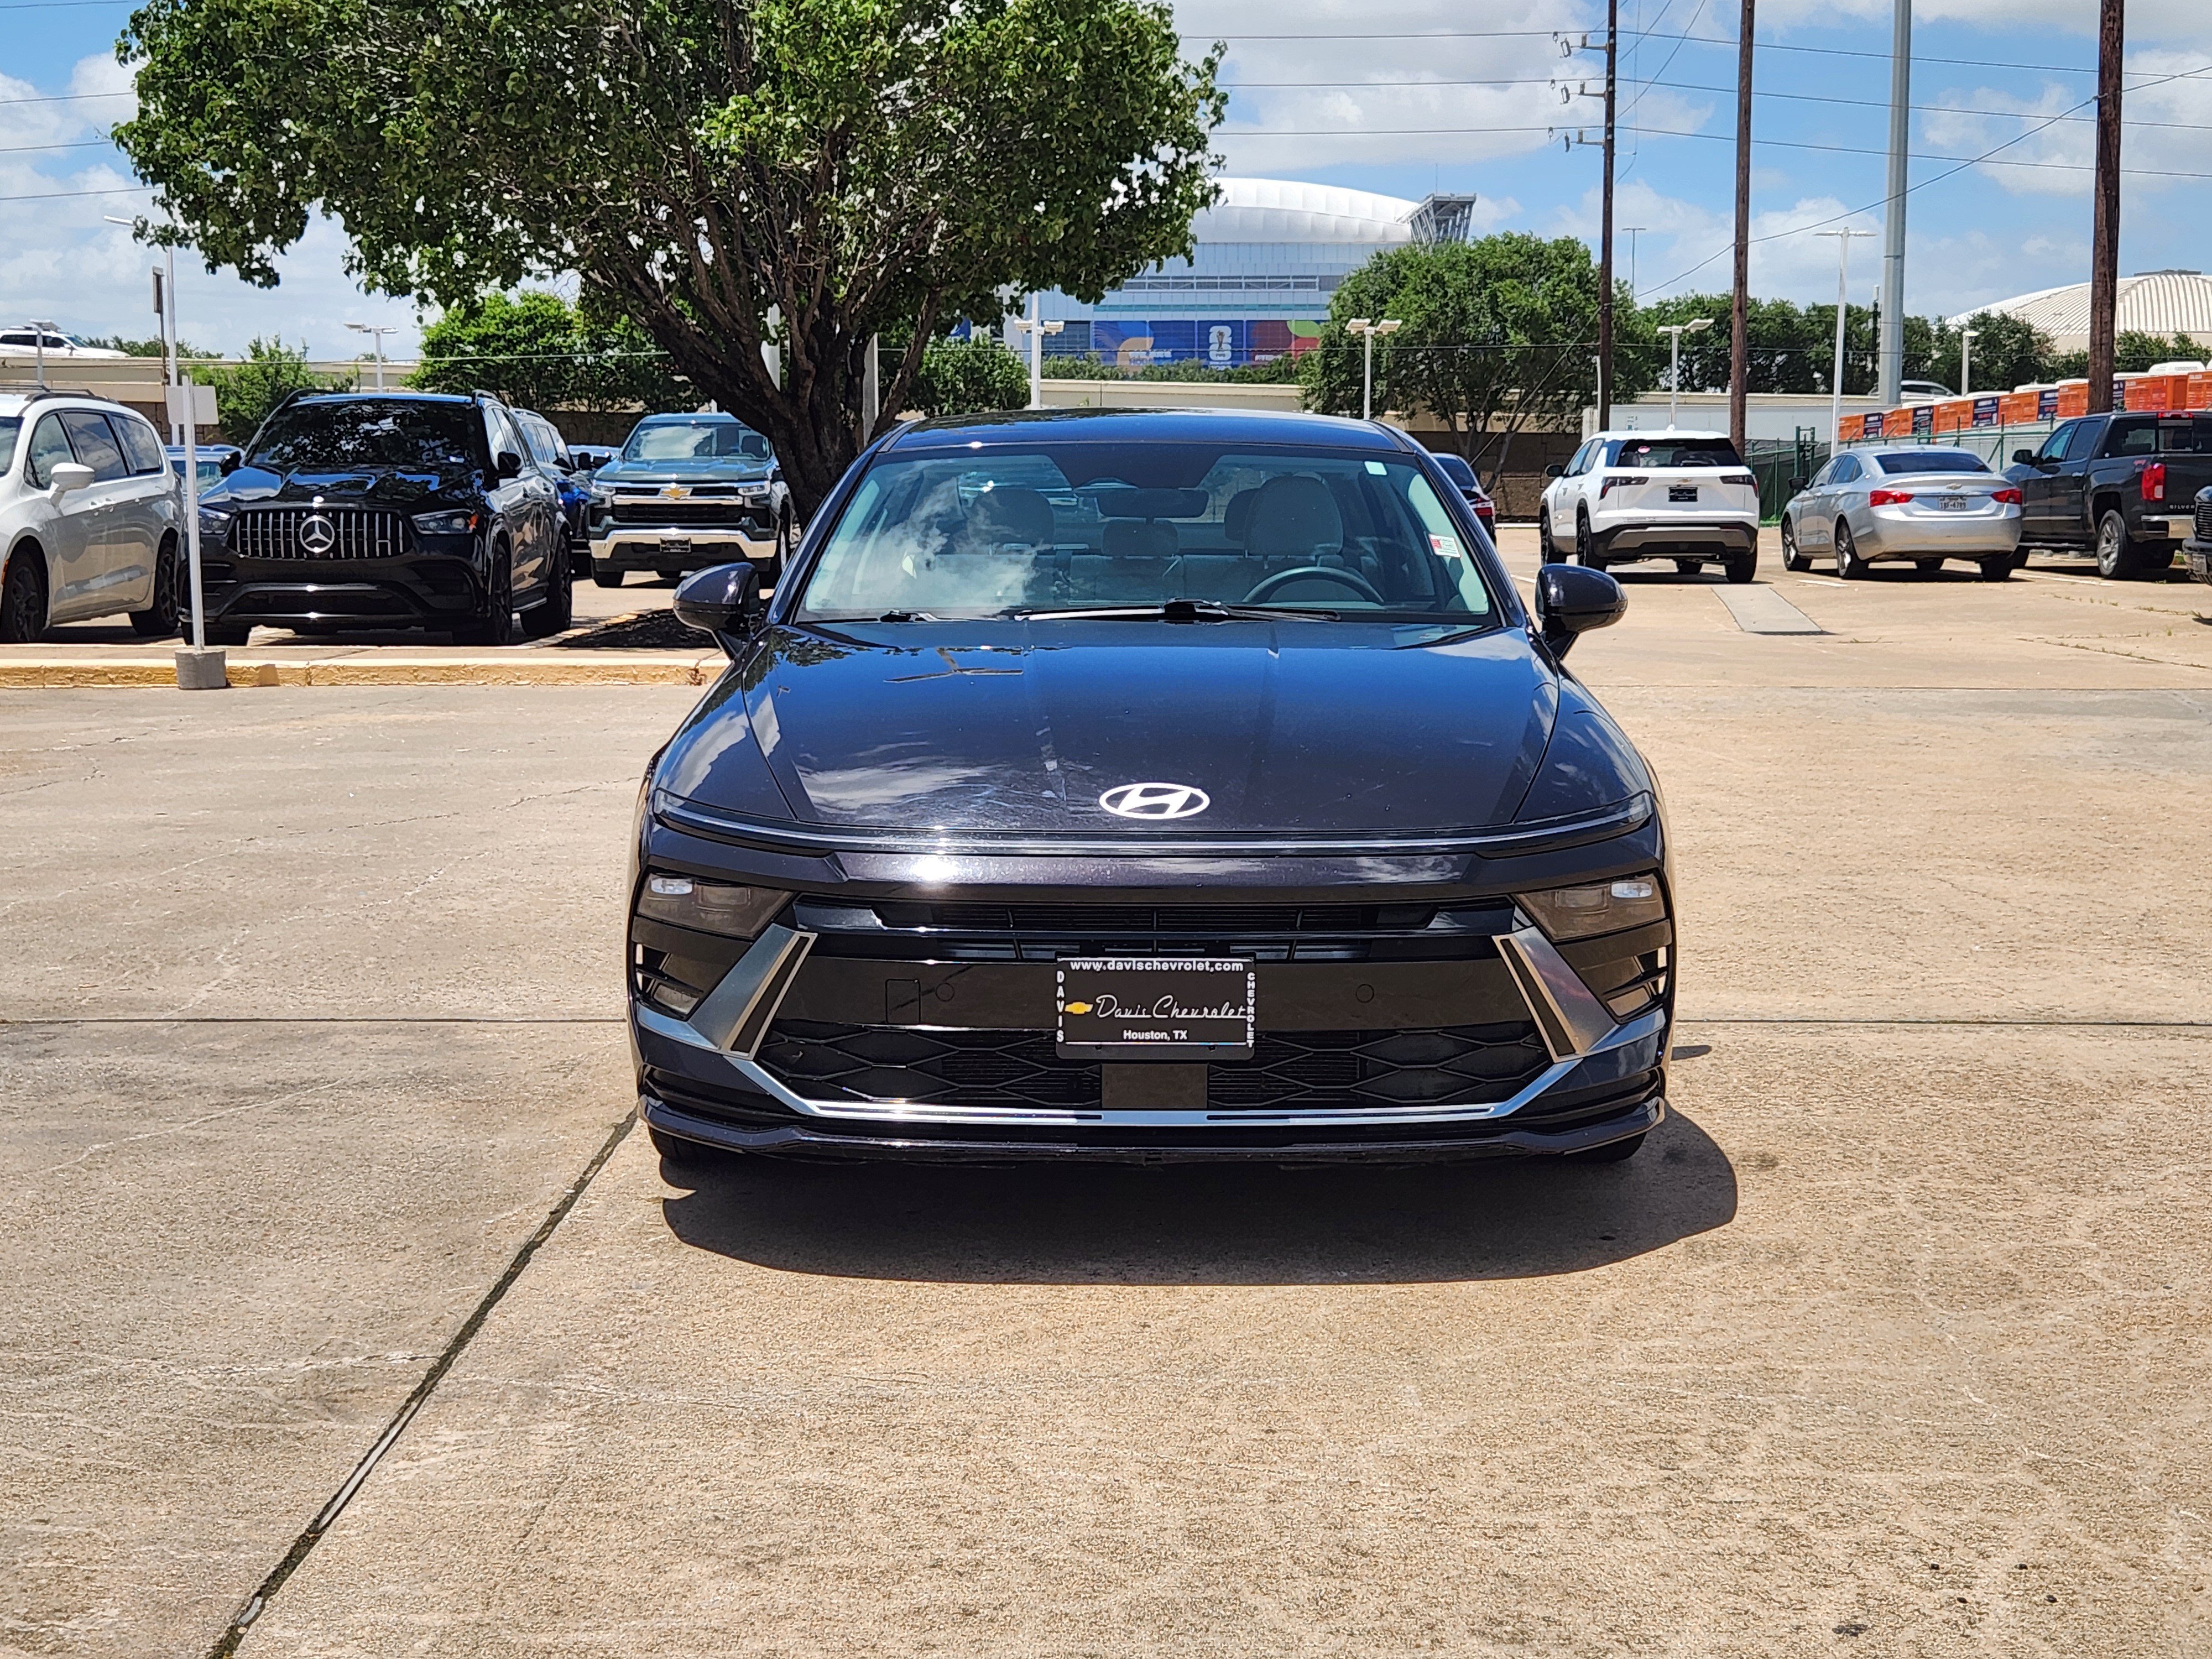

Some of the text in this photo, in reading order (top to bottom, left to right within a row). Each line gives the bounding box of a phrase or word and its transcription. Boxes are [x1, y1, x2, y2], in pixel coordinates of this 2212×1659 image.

[1070, 961, 1244, 972] www.davischevrolet.com
[1056, 971, 1065, 1042] DAVIS
[1096, 994, 1247, 1018] Davis Chevrolet
[1246, 972, 1256, 1048] CHEVROLET
[1123, 1030, 1188, 1041] Houston, TX
